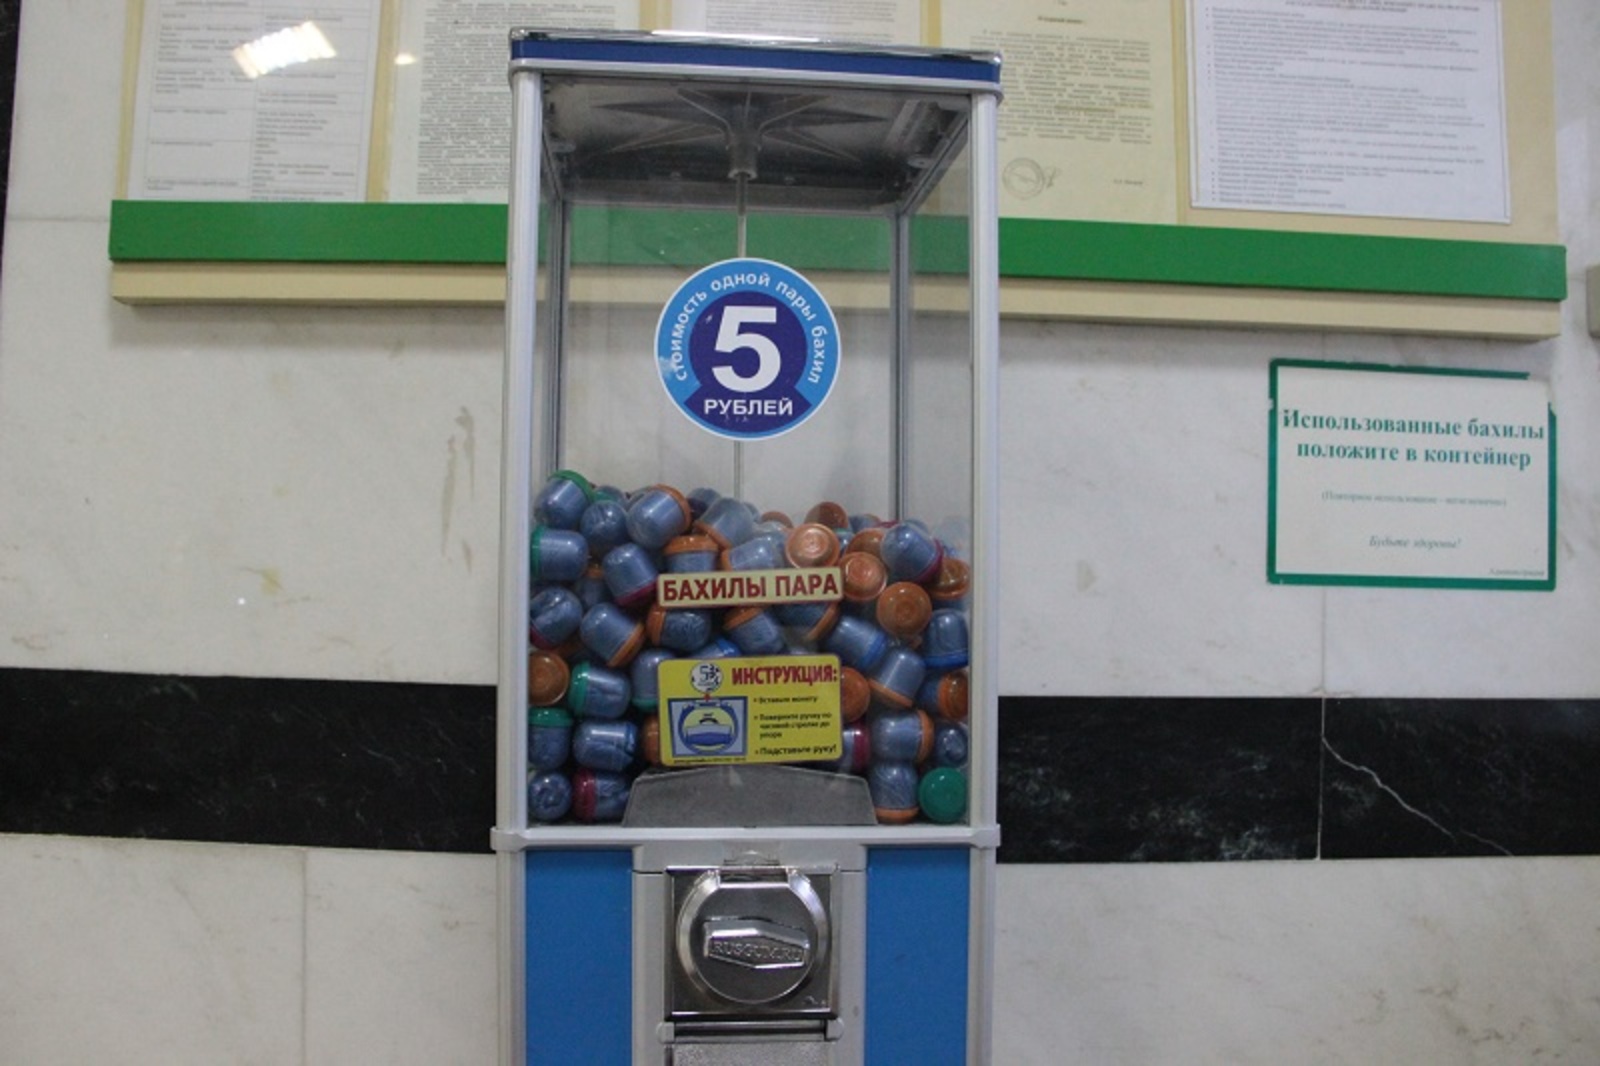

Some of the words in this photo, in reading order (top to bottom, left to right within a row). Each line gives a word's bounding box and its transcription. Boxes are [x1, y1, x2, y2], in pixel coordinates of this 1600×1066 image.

[671, 291, 707, 381] стоимость
[711, 273, 771, 291] одной
[776, 282, 816, 321] пары
[808, 325, 828, 384] бахил
[711, 305, 782, 393] 5
[704, 397, 794, 416] РУБЛЕЙ
[1282, 408, 1463, 436] Использованные
[1467, 417, 1545, 439] бахилы
[1296, 442, 1399, 462] положите
[1406, 446, 1418, 462] в
[1424, 447, 1531, 471] контейнер
[663, 577, 766, 601] БАХИЛЫ
[775, 574, 838, 597] ПАРА
[731, 665, 838, 686] ИНСТРУКЦИЯ:
